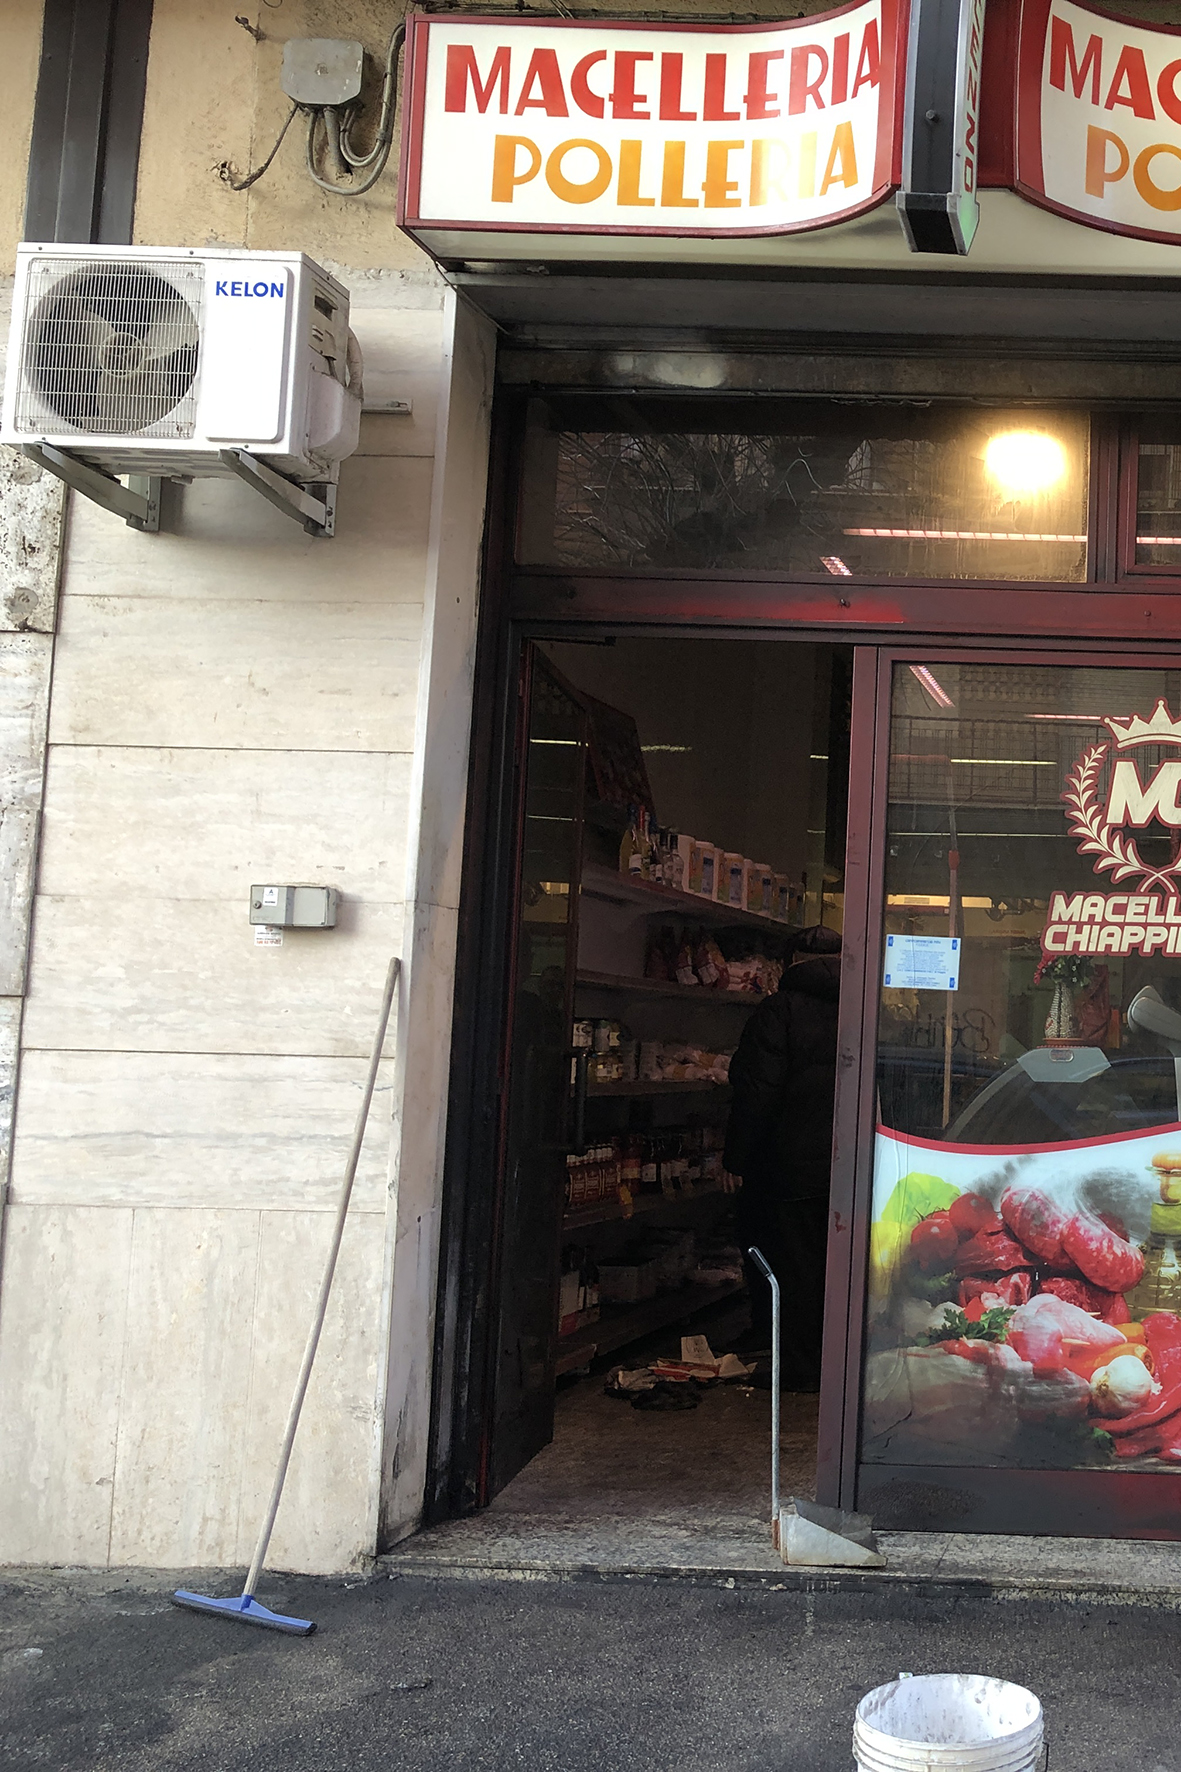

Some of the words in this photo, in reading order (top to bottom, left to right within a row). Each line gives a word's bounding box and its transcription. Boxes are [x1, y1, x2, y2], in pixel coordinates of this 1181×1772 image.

[444, 18, 880, 121] MACELLERIA
[491, 120, 859, 207] POLLERIA
[215, 280, 284, 298] KELON
